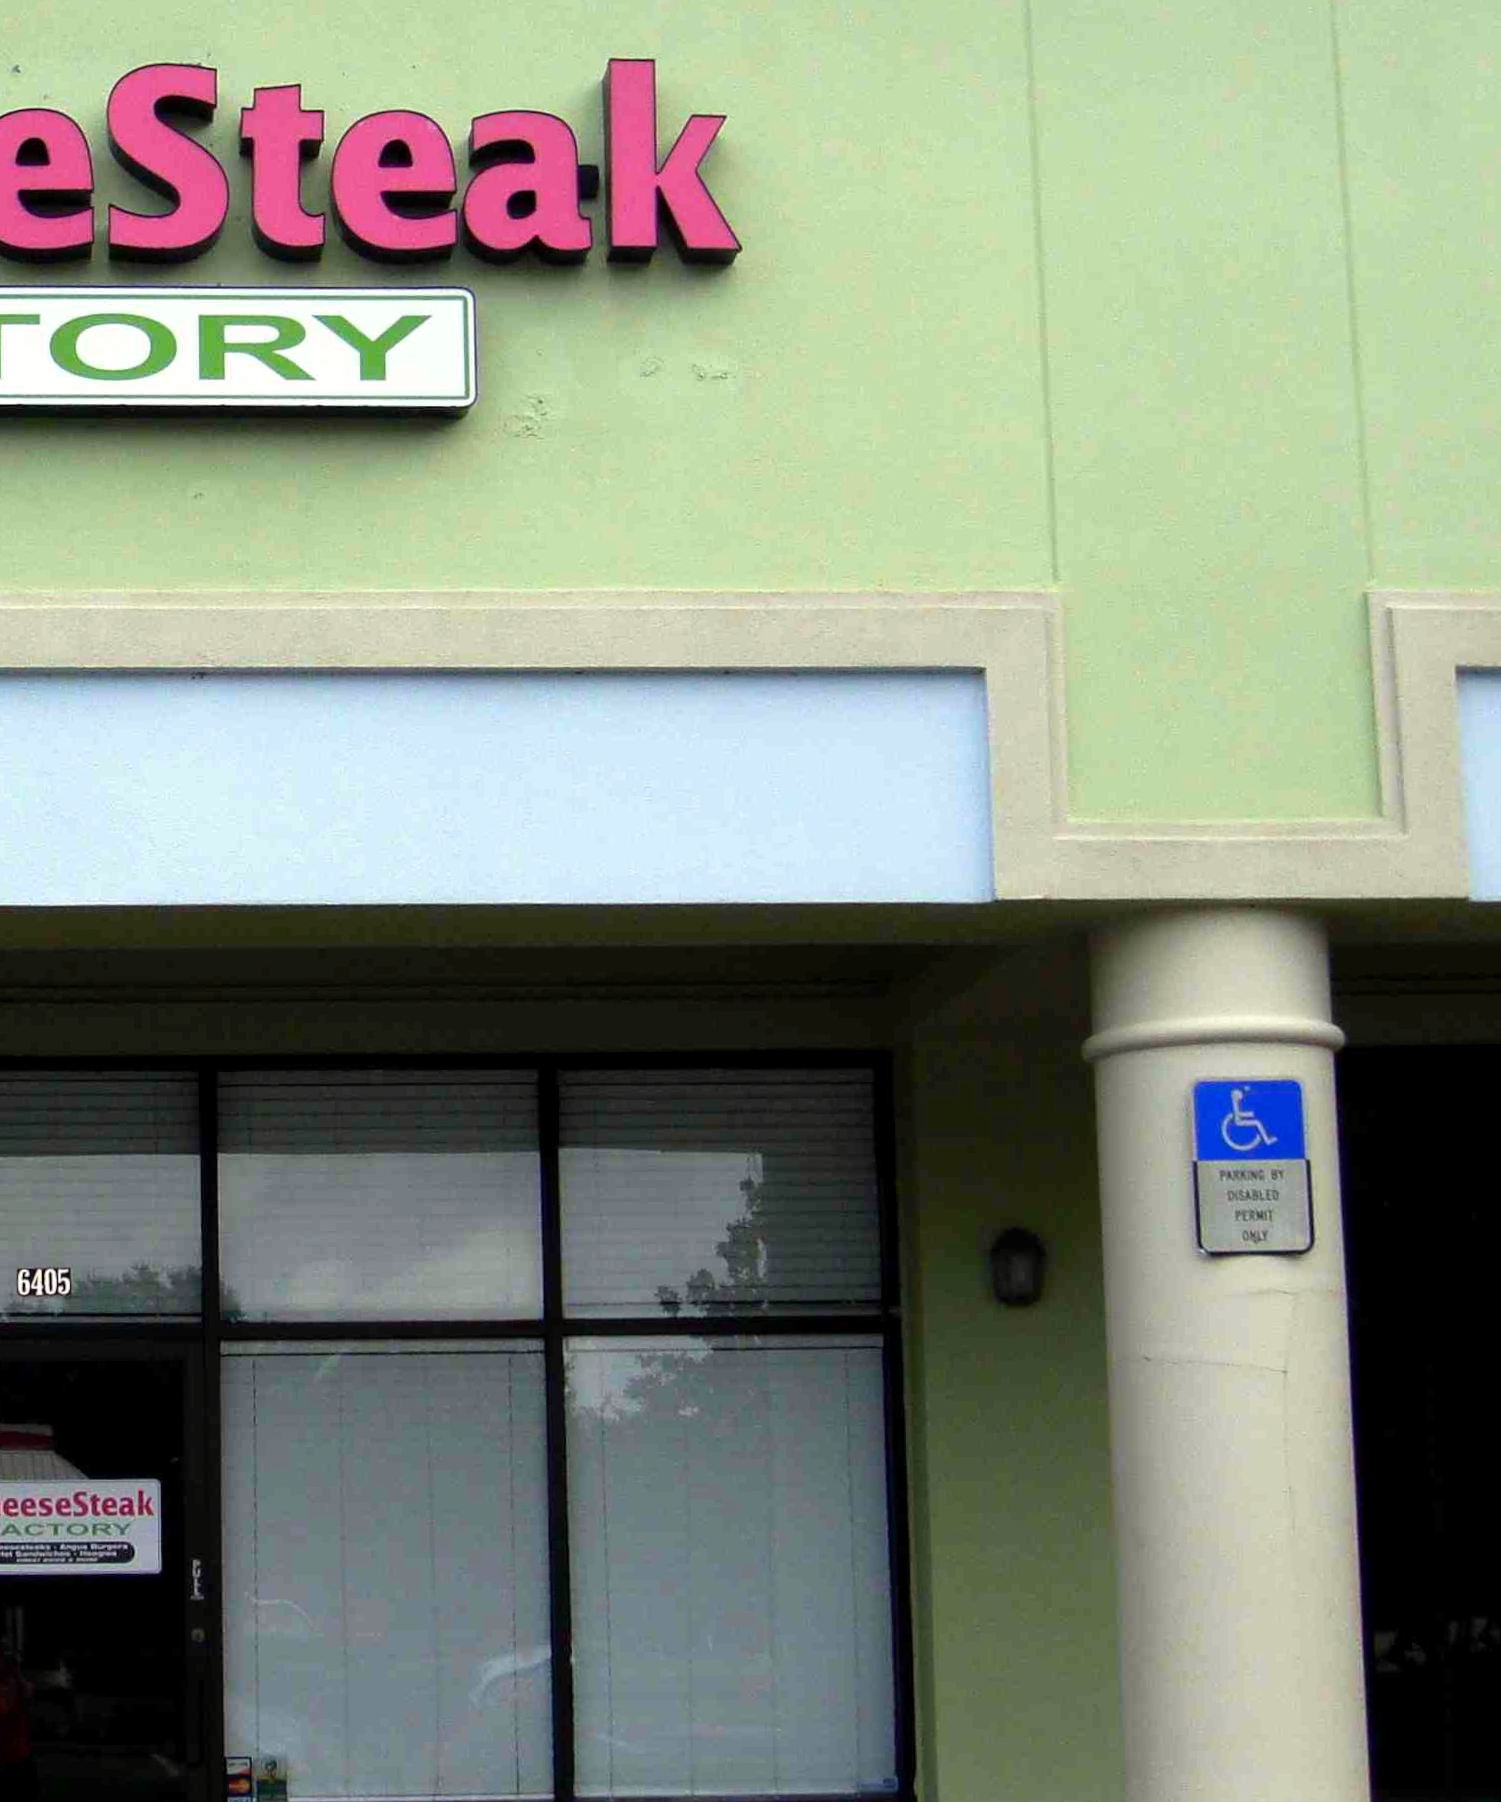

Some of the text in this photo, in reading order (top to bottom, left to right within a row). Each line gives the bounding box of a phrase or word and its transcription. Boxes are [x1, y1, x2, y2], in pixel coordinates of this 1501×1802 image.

[1219, 1169, 1284, 1182] PARKING BY
[1227, 1189, 1279, 1201] DISABLED
[1235, 1210, 1274, 1222] PERMIT
[1242, 1230, 1269, 1243] ONLY
[17, 1268, 72, 1296] 6405
